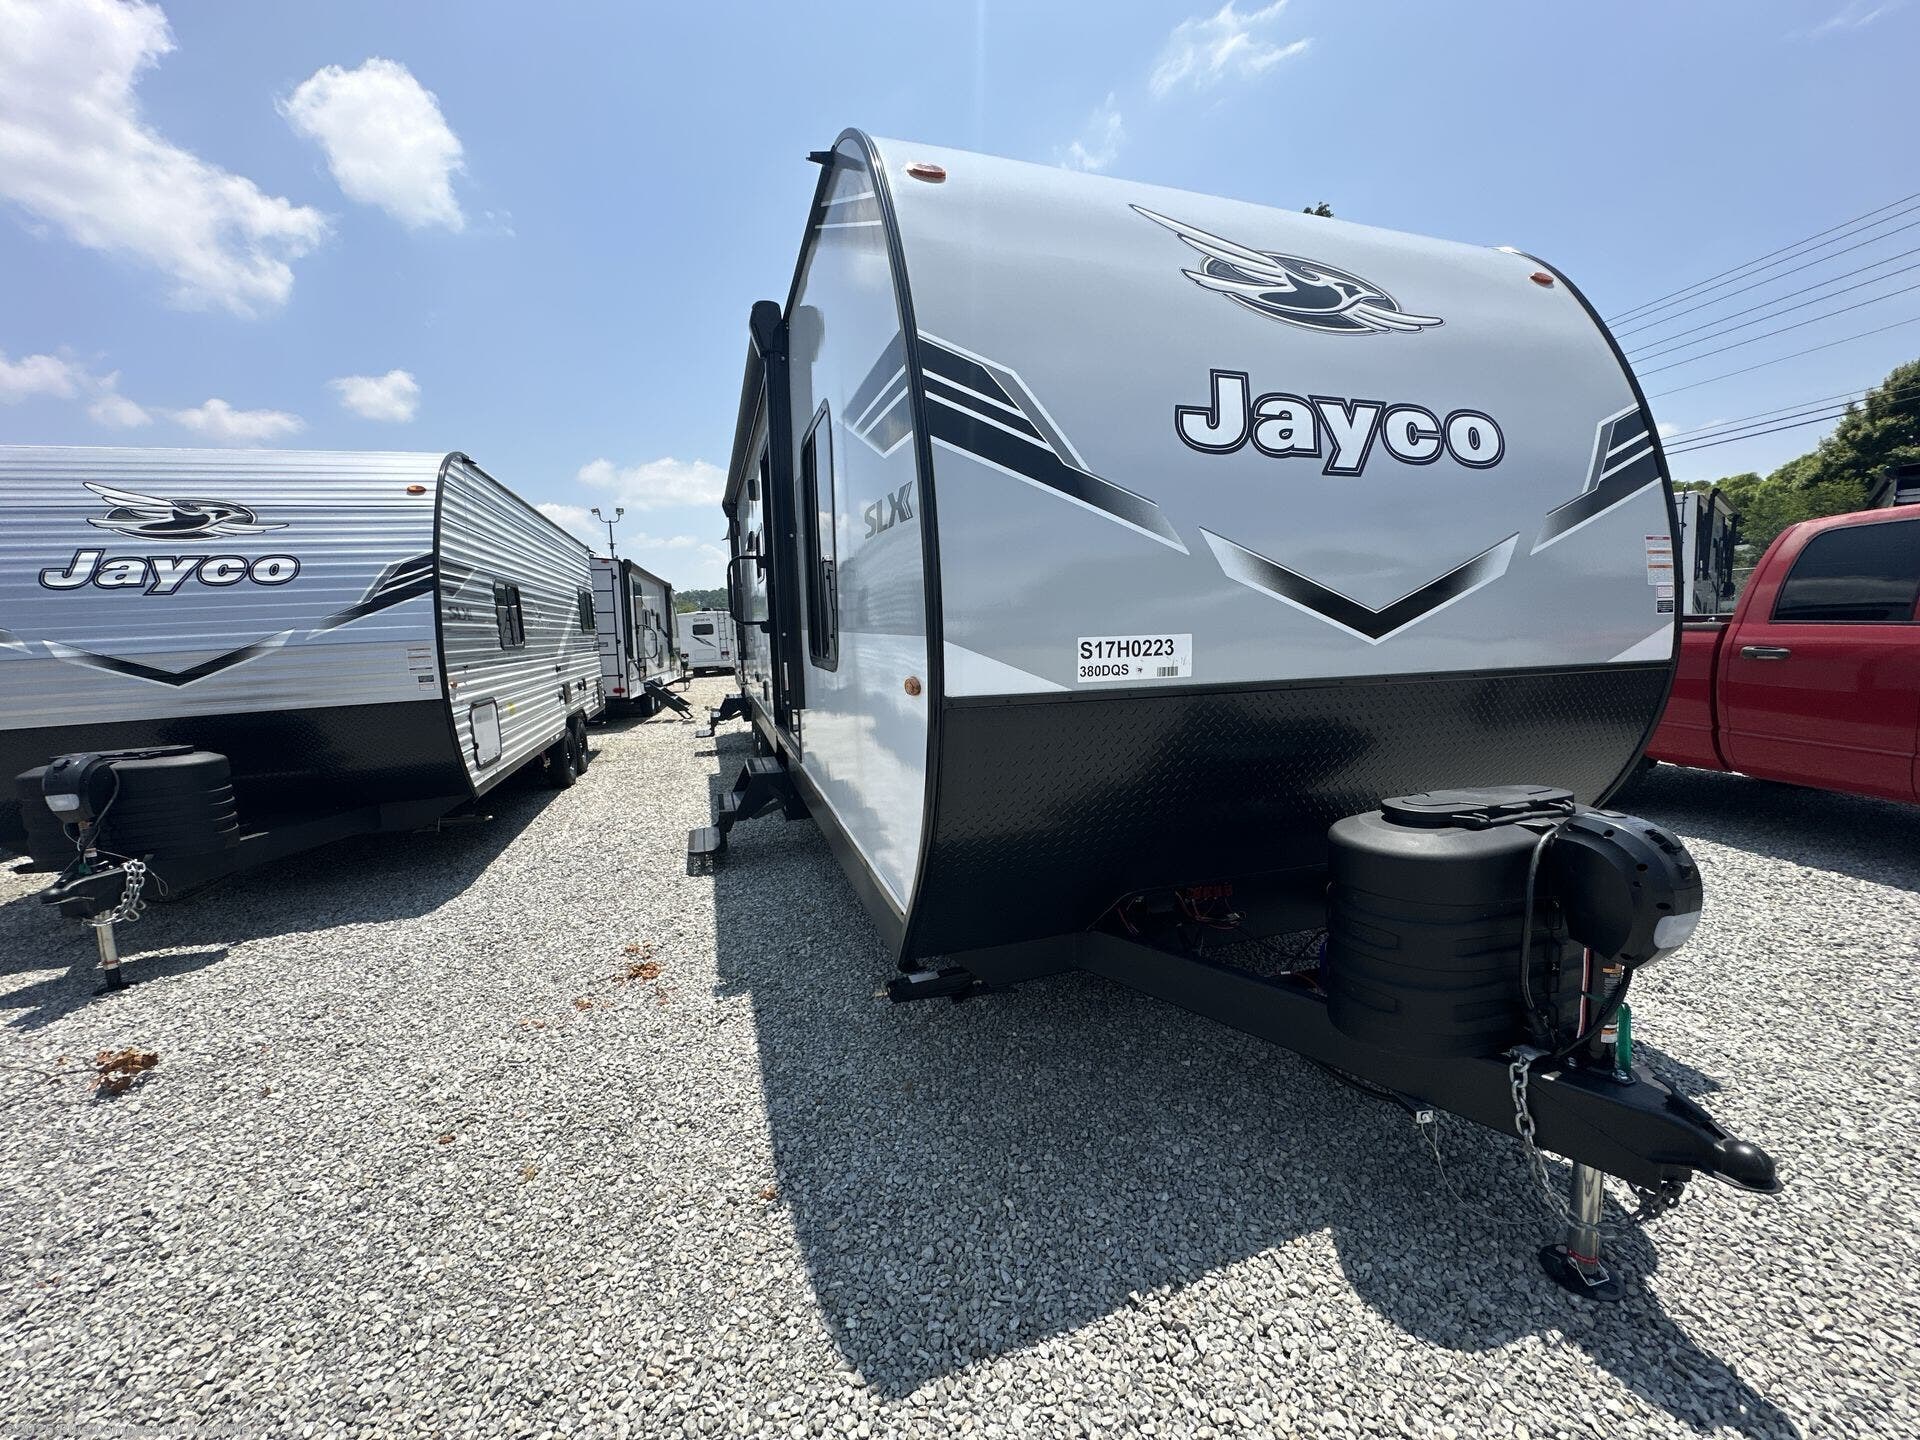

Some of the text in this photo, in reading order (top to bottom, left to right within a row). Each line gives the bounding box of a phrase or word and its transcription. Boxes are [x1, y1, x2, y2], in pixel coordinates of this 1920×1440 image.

[1175, 368, 1505, 477] Jayco
[864, 480, 913, 539] SLX
[38, 548, 301, 596] Jayco
[1079, 664, 1129, 677] 380DQS
[1080, 639, 1174, 660] S17H0223
